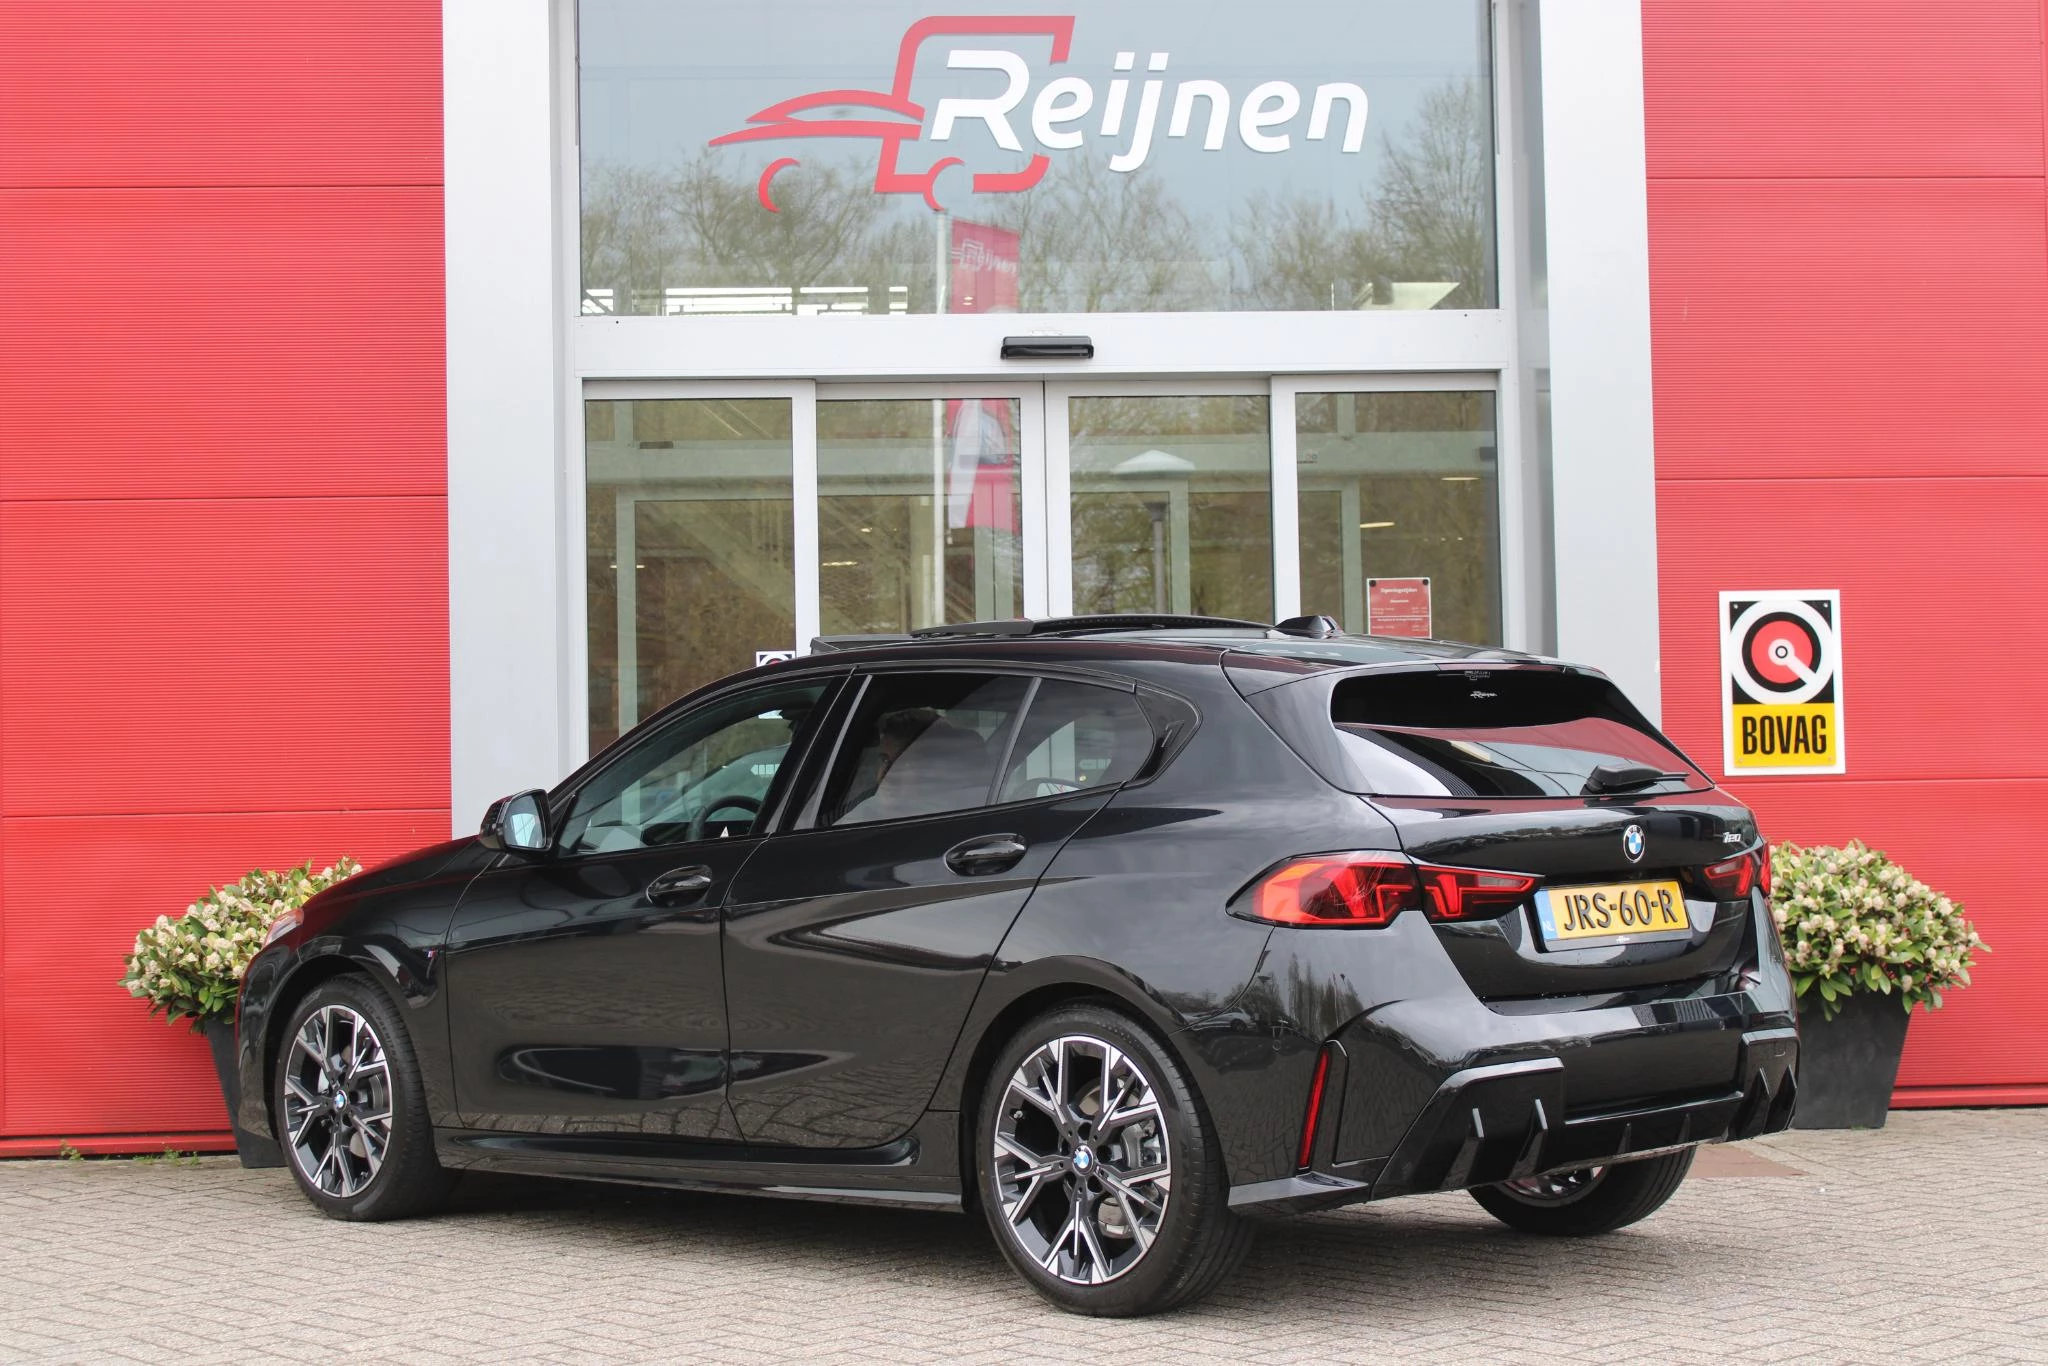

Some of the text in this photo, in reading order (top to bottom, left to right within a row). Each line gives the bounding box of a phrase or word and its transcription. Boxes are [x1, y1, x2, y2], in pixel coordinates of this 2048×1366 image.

[930, 49, 1368, 172] Reijnen
[1742, 715, 1826, 755] BOVAG
[1564, 889, 1678, 931] JRS-60-R
